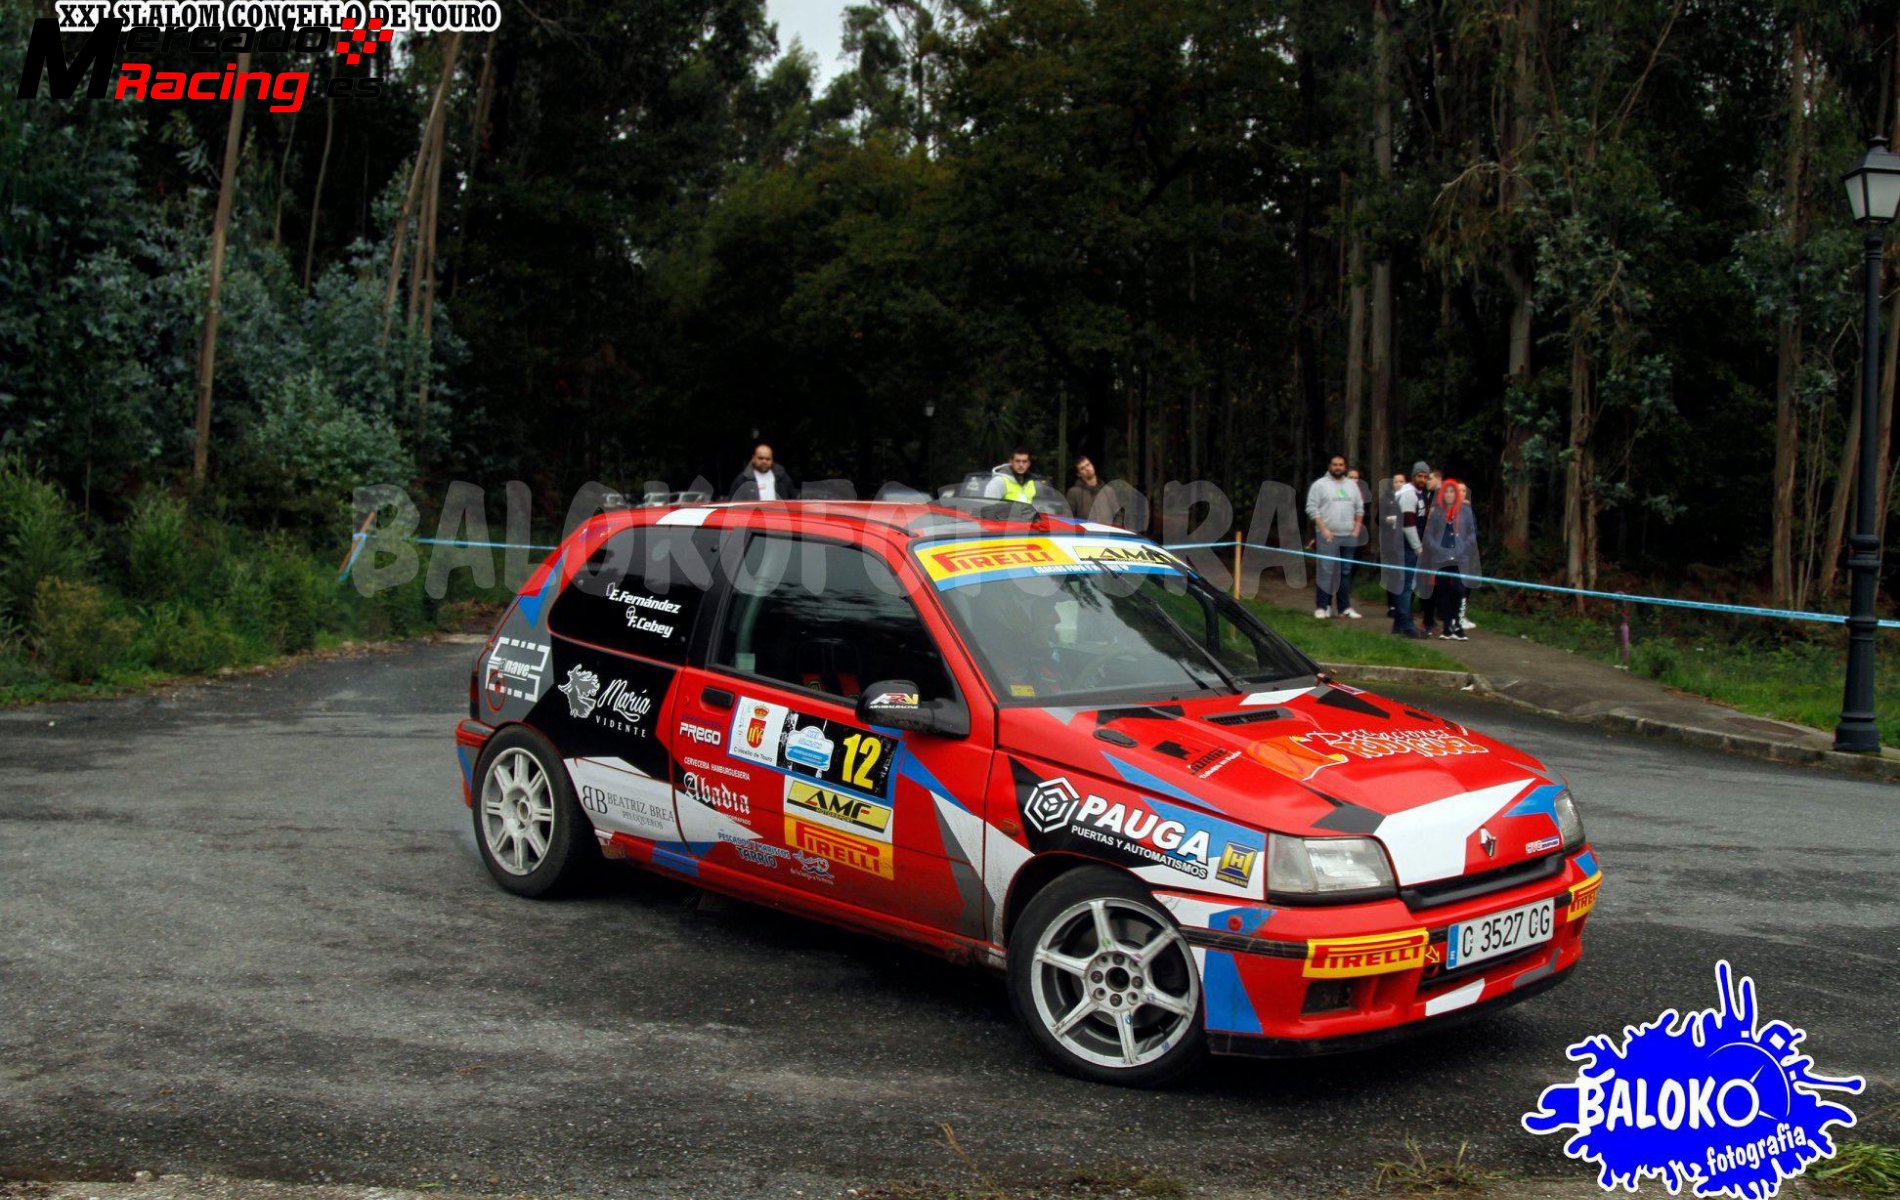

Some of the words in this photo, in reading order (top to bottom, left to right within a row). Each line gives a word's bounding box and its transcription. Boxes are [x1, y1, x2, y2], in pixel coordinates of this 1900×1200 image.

[930, 543, 1055, 573] PIRELLI
[609, 587, 682, 614] E.Fernández
[627, 615, 674, 638] F.Cebey
[597, 678, 652, 722] María
[595, 715, 647, 738] VIDENTE
[843, 733, 882, 790] 12
[607, 792, 647, 815] BEATRIZ
[649, 804, 675, 823] BREA
[804, 789, 872, 820] AMF
[796, 821, 880, 873] PIRELLI
[1075, 794, 1209, 866] PAUGA
[1071, 824, 1114, 847] PUERTAS
[1116, 838, 1124, 849] Y
[1124, 842, 1208, 879] AUTOMATISMOS
[1462, 925, 1474, 958] C
[1481, 911, 1525, 953] 3527
[1528, 904, 1550, 939] CG
[1311, 934, 1424, 969] PIRELLI
